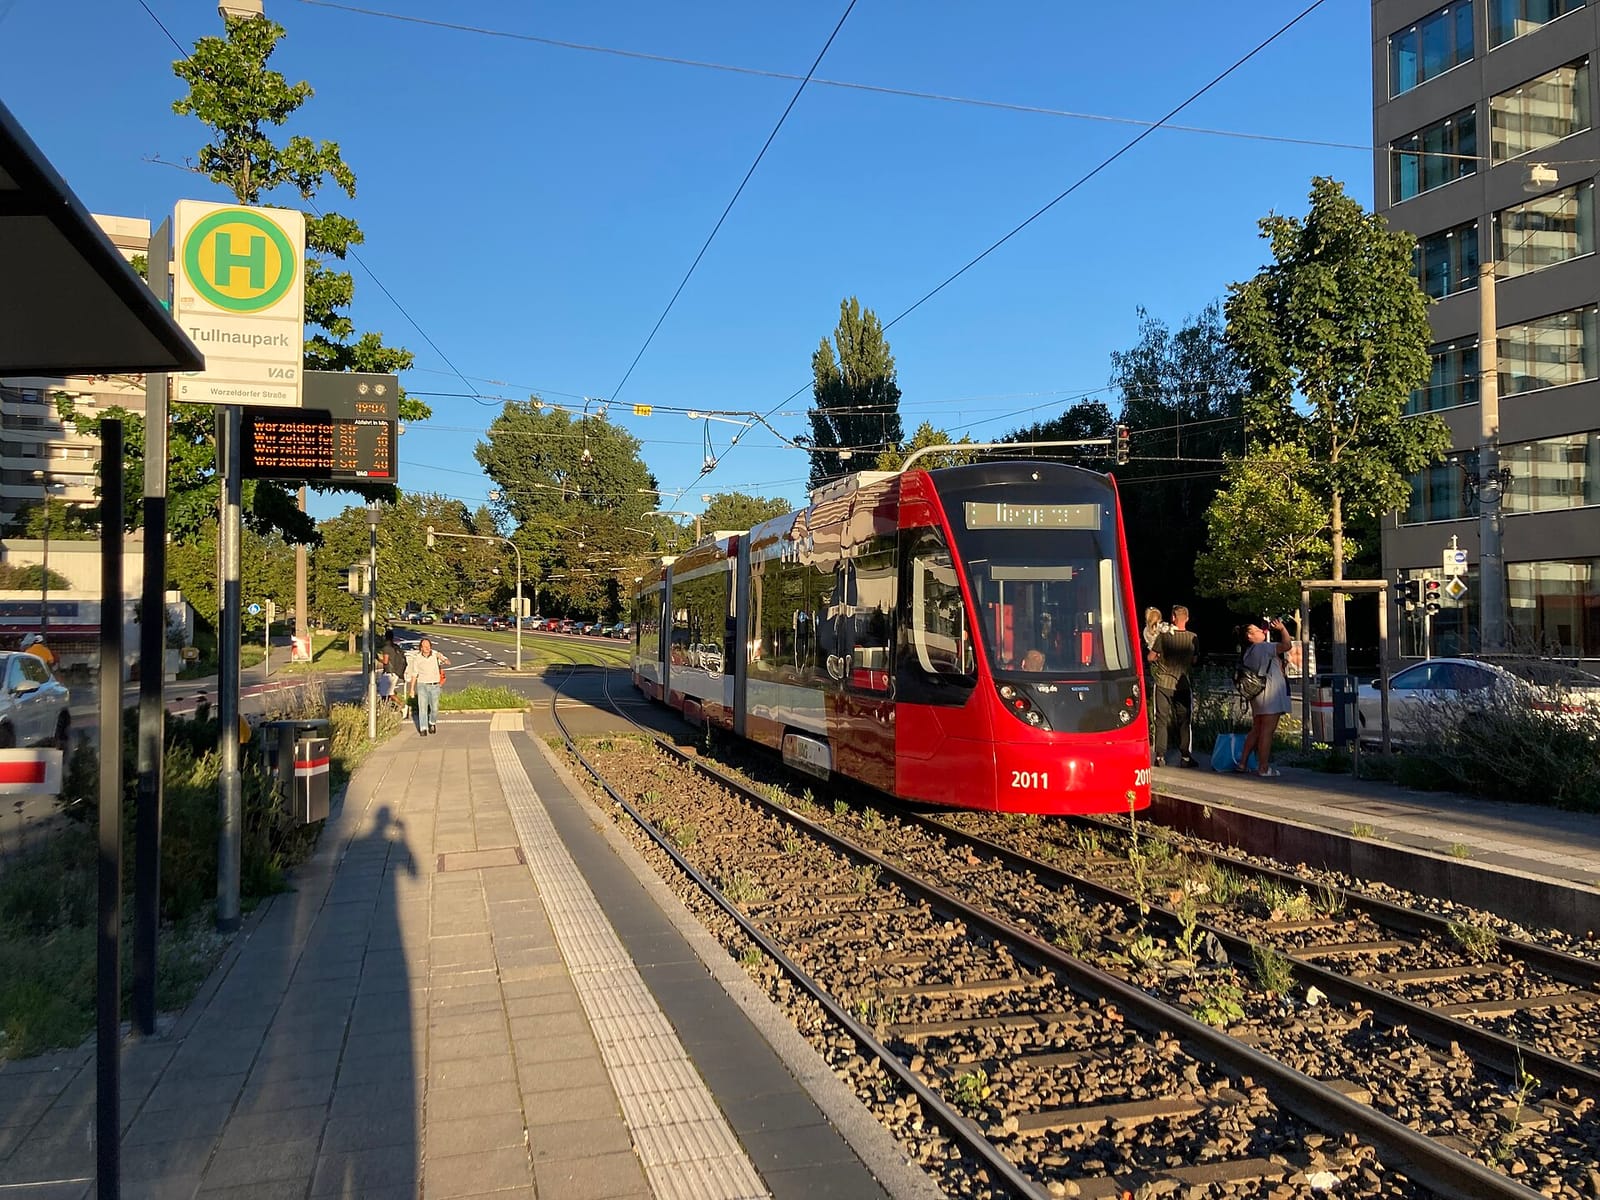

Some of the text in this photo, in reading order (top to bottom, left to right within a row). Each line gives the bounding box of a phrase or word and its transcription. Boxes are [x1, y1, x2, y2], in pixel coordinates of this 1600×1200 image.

[215, 232, 266, 289] H
[189, 327, 289, 347] Tullnaupark
[267, 367, 295, 379] VAG
[181, 385, 188, 394] 5
[210, 387, 287, 399] Worzeldorfer Straße
[1011, 771, 1048, 789] 2011
